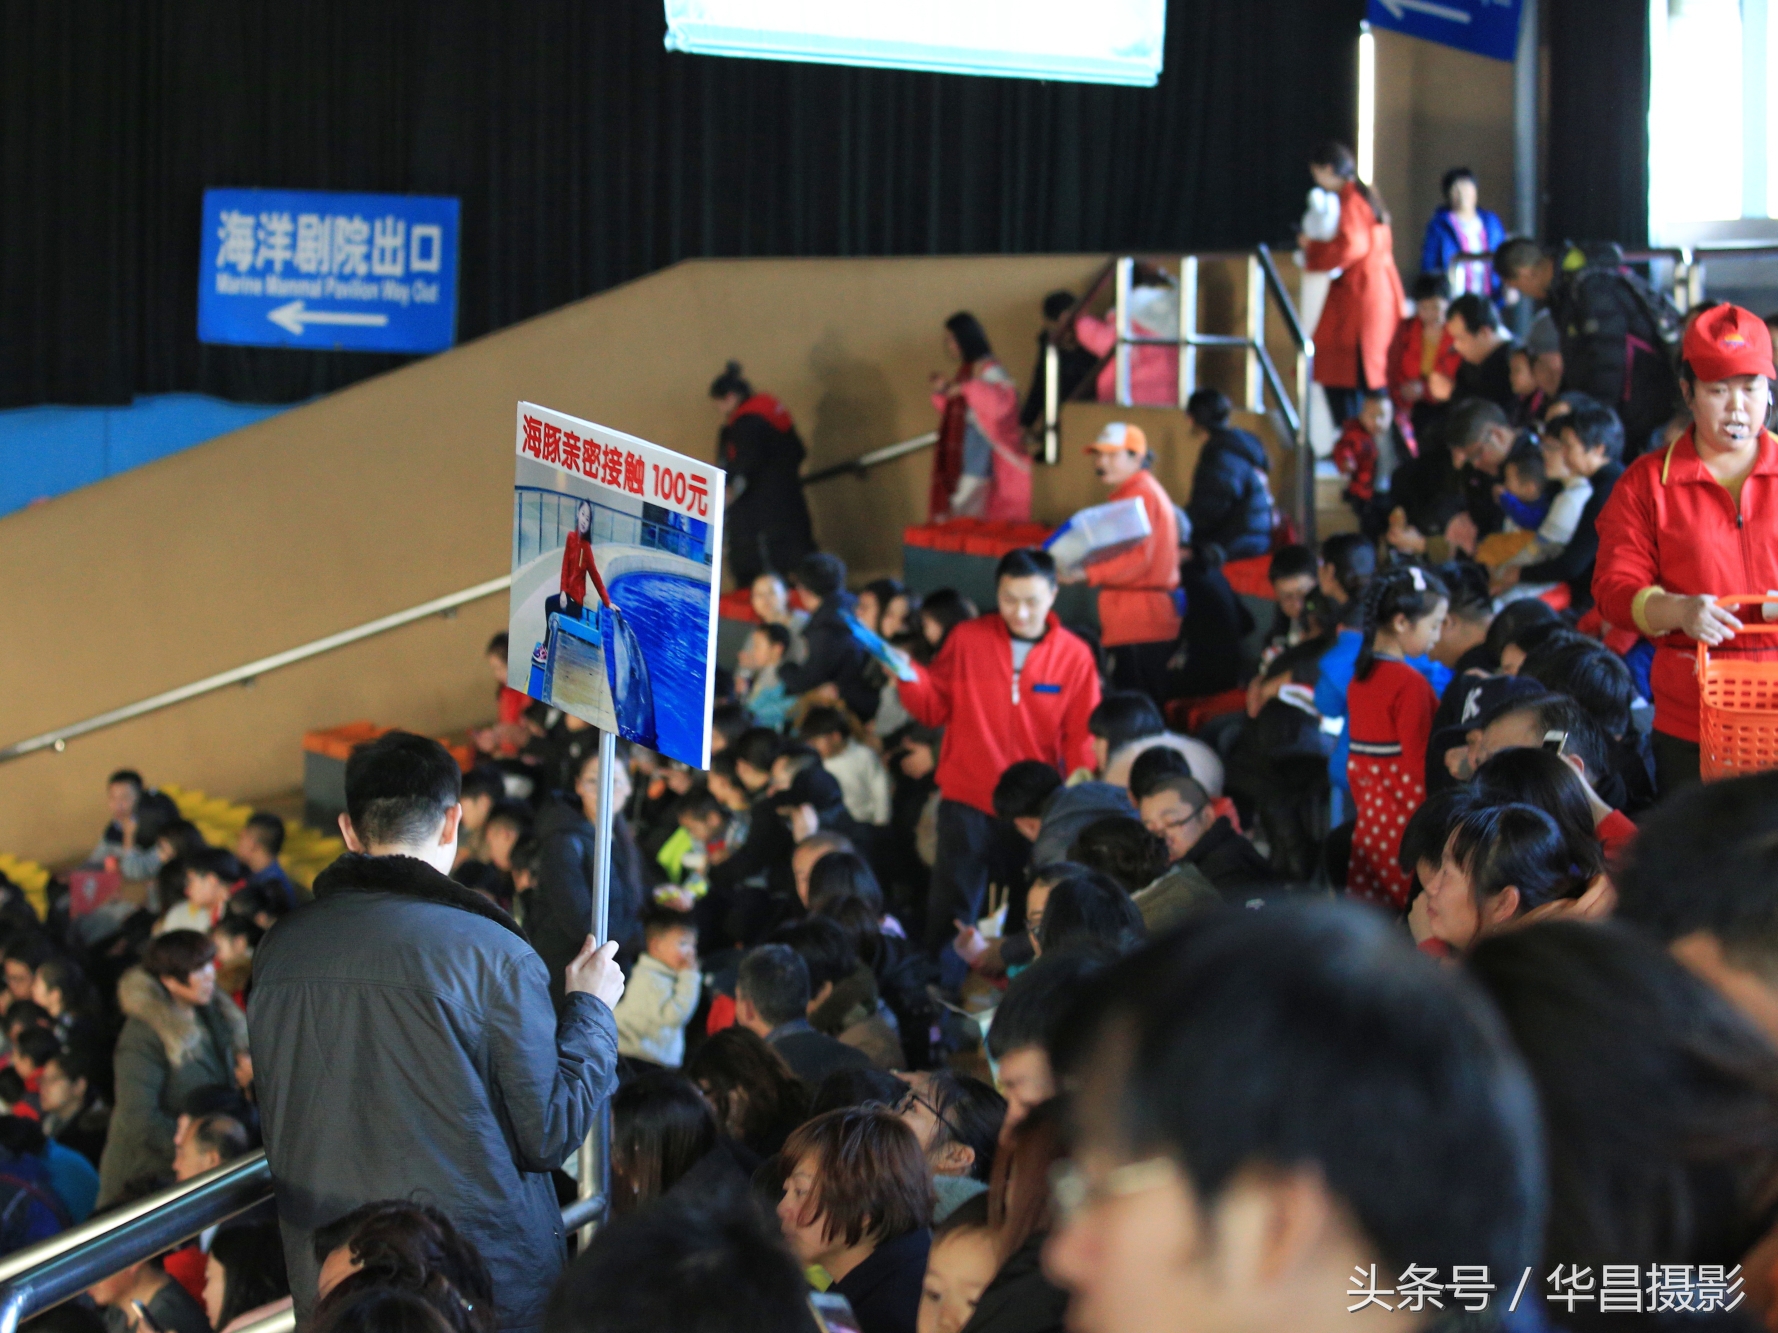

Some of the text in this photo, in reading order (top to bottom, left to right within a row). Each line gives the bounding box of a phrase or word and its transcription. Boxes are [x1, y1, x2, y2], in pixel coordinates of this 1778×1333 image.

[216, 210, 442, 277] 海洋剧院出口
[522, 414, 708, 517] 海豚亲密接触 100元
